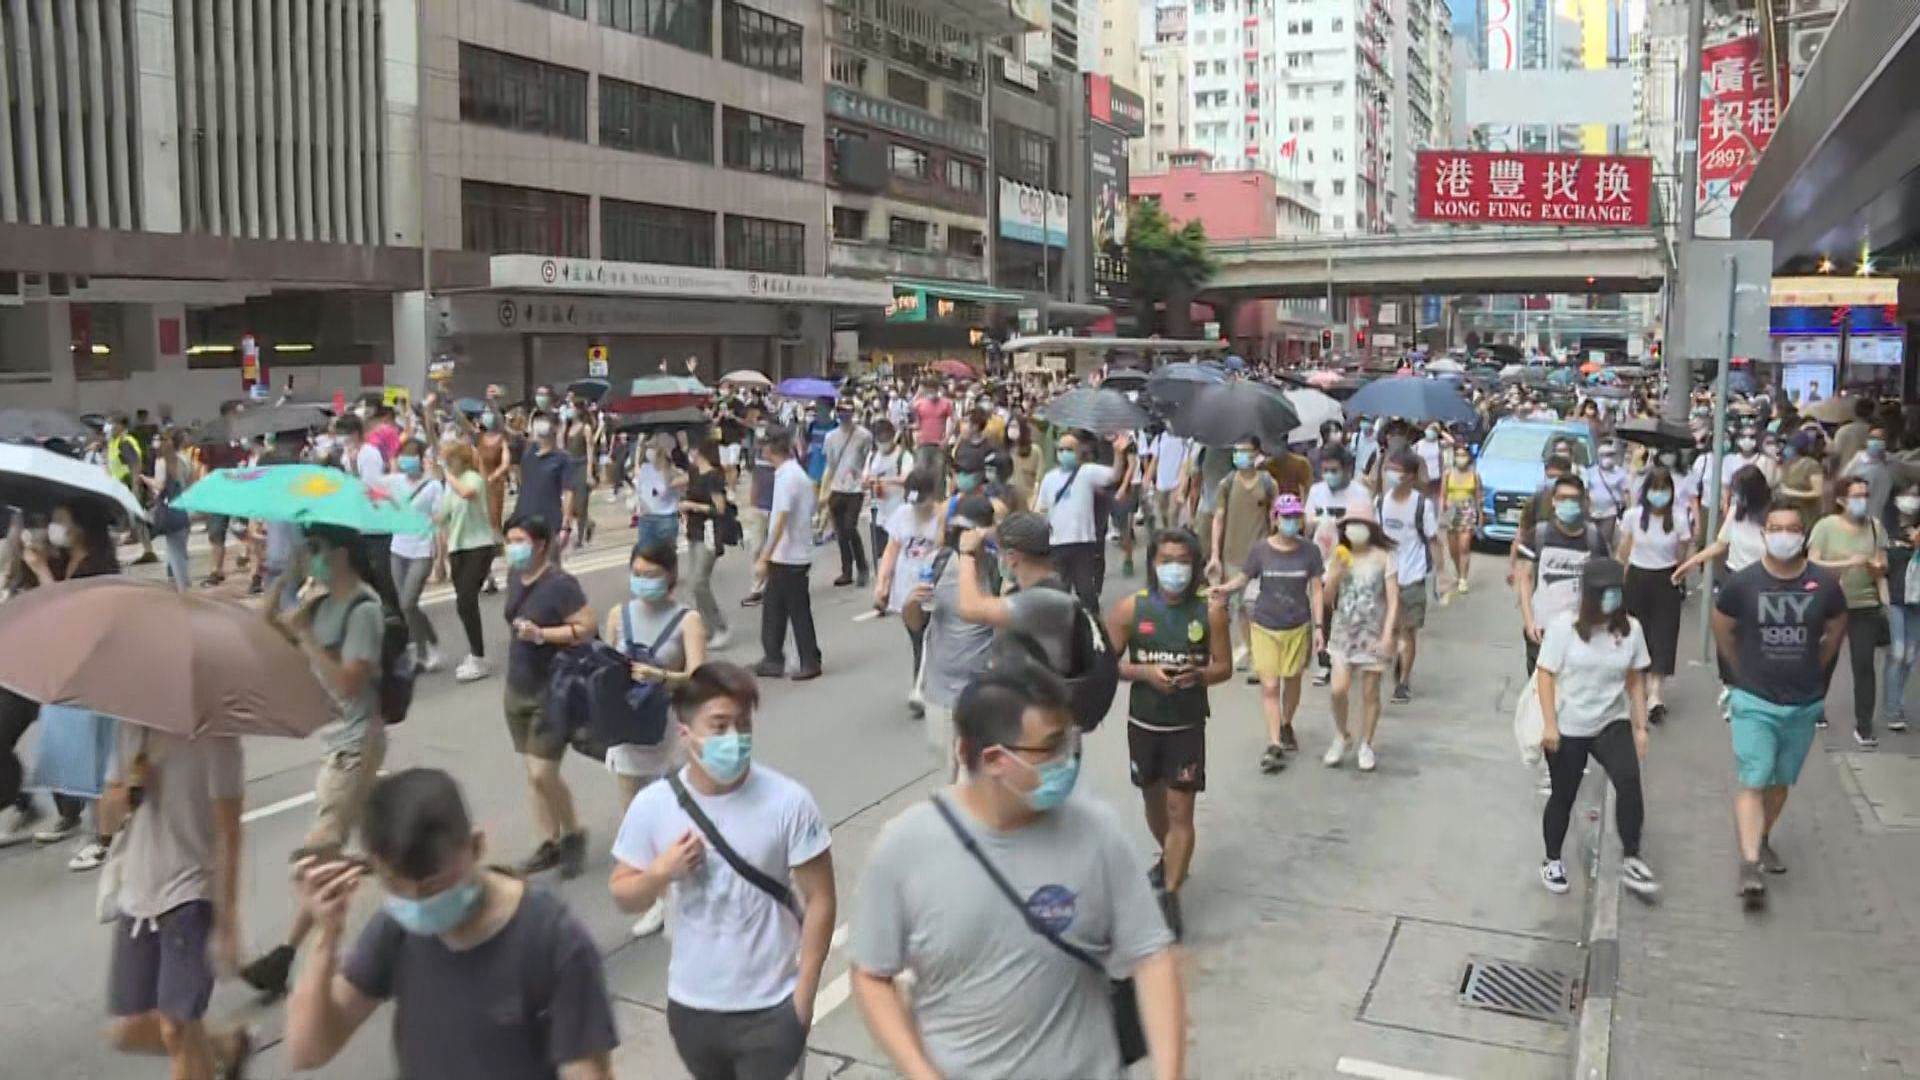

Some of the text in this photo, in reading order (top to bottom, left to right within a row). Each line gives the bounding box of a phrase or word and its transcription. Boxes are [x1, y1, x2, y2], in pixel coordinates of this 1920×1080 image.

[1709, 98, 1777, 140] 招租
[1434, 200, 1632, 222] KONG FUNG EXCHANGE
[1758, 595, 1814, 624] NY
